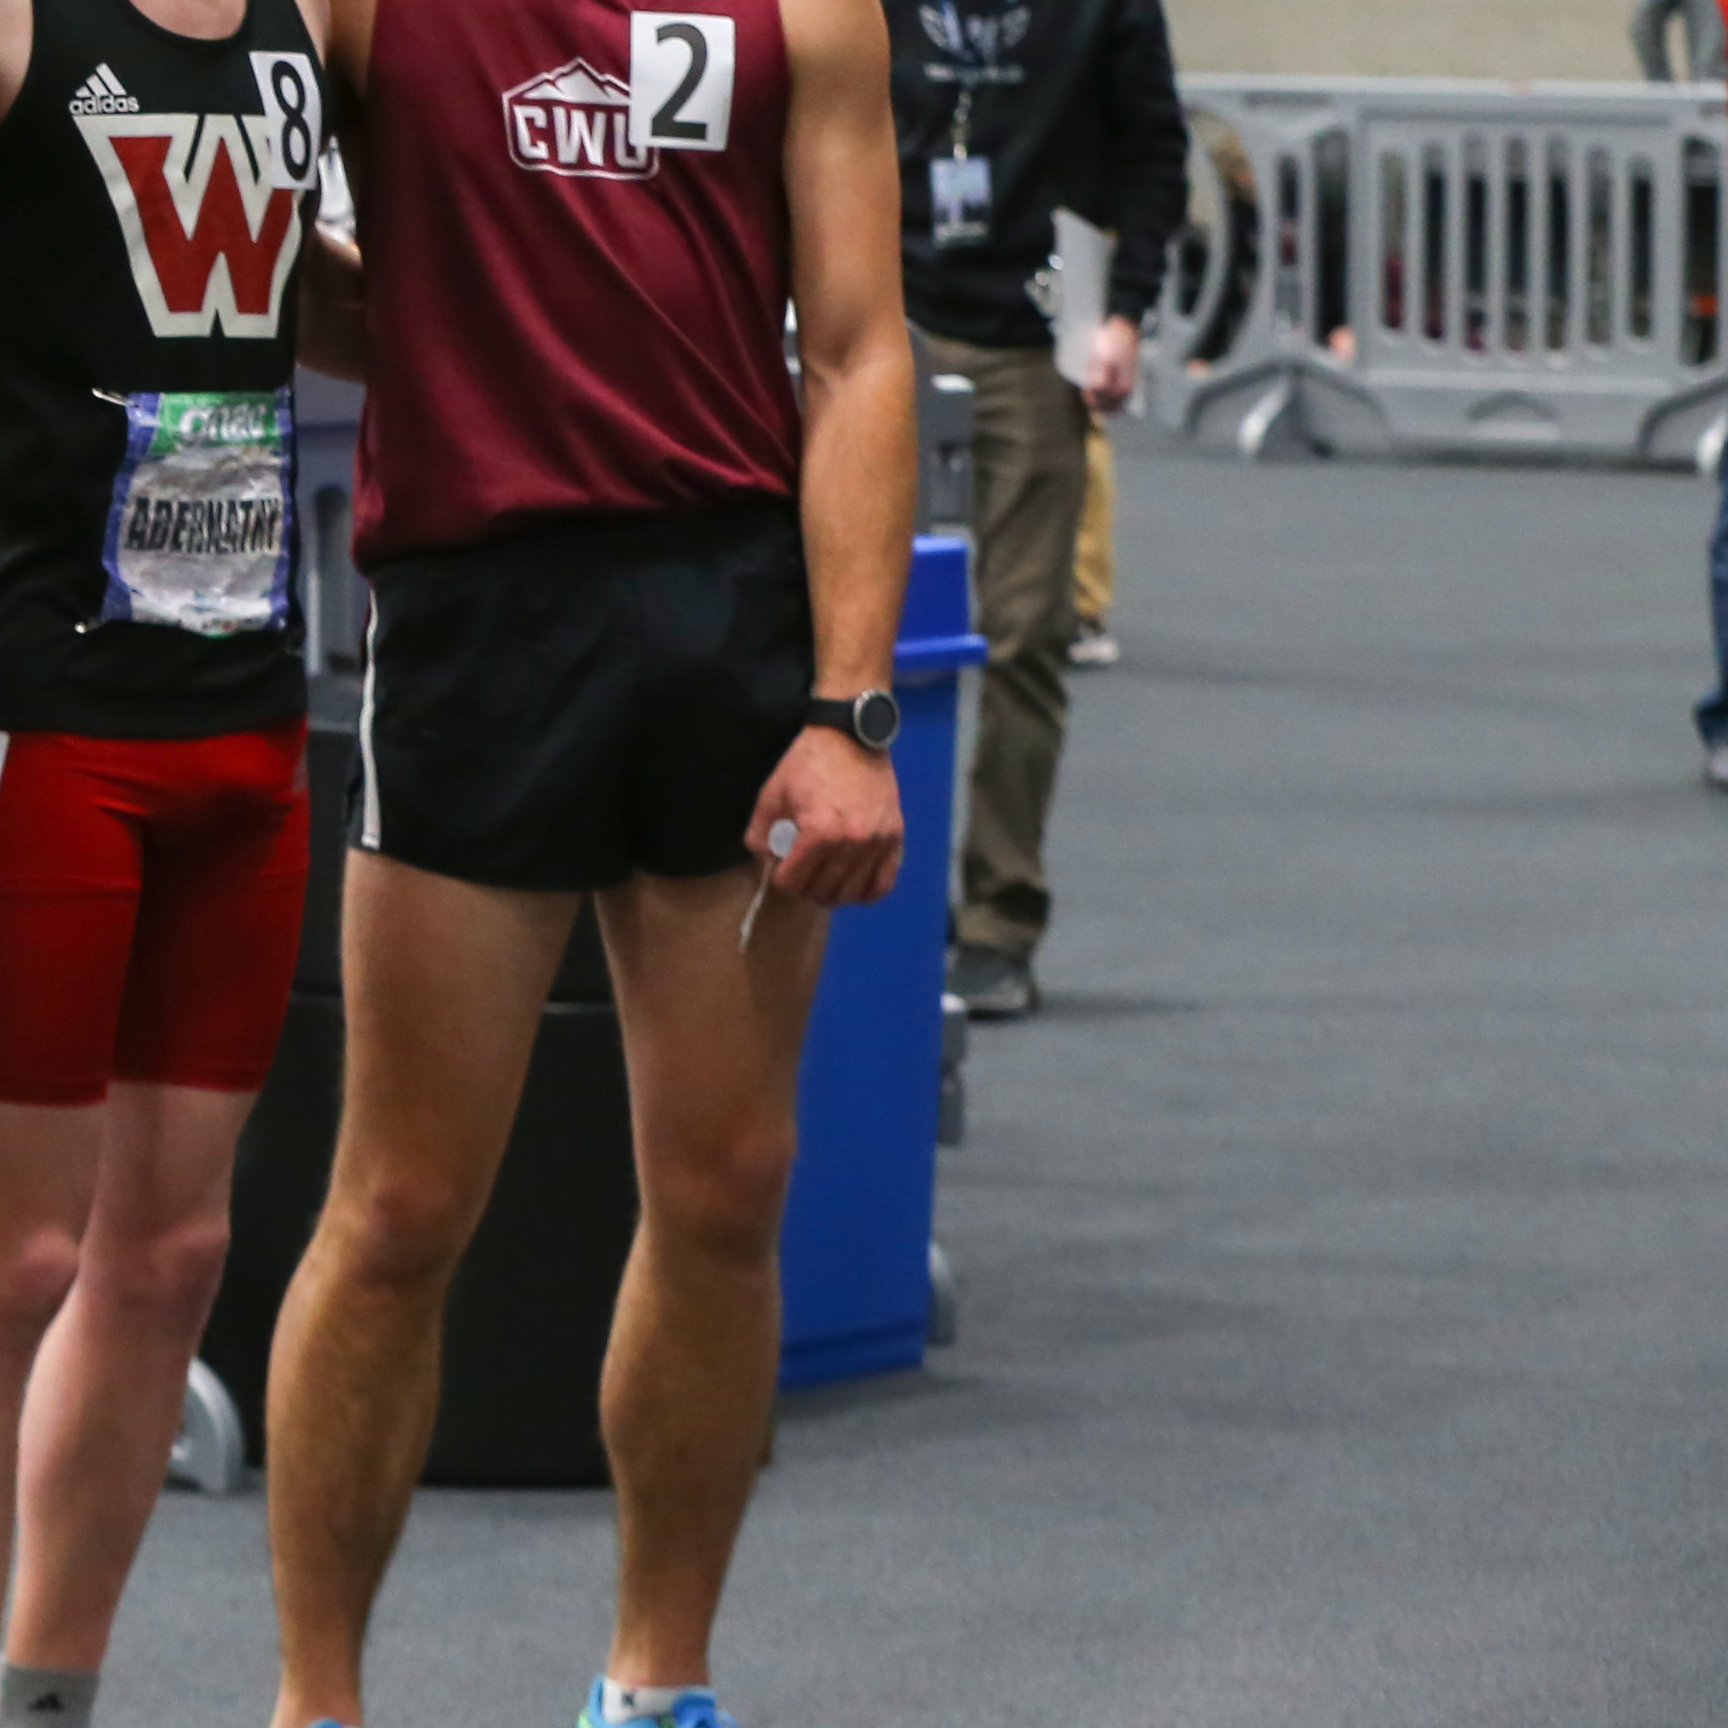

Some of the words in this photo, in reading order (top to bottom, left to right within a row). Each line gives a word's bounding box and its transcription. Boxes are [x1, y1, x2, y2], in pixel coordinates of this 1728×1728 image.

[69, 95, 140, 114] adidas
[270, 60, 312, 181] 8
[513, 104, 648, 168] CWU
[651, 23, 708, 142] 2
[72, 113, 303, 339] W
